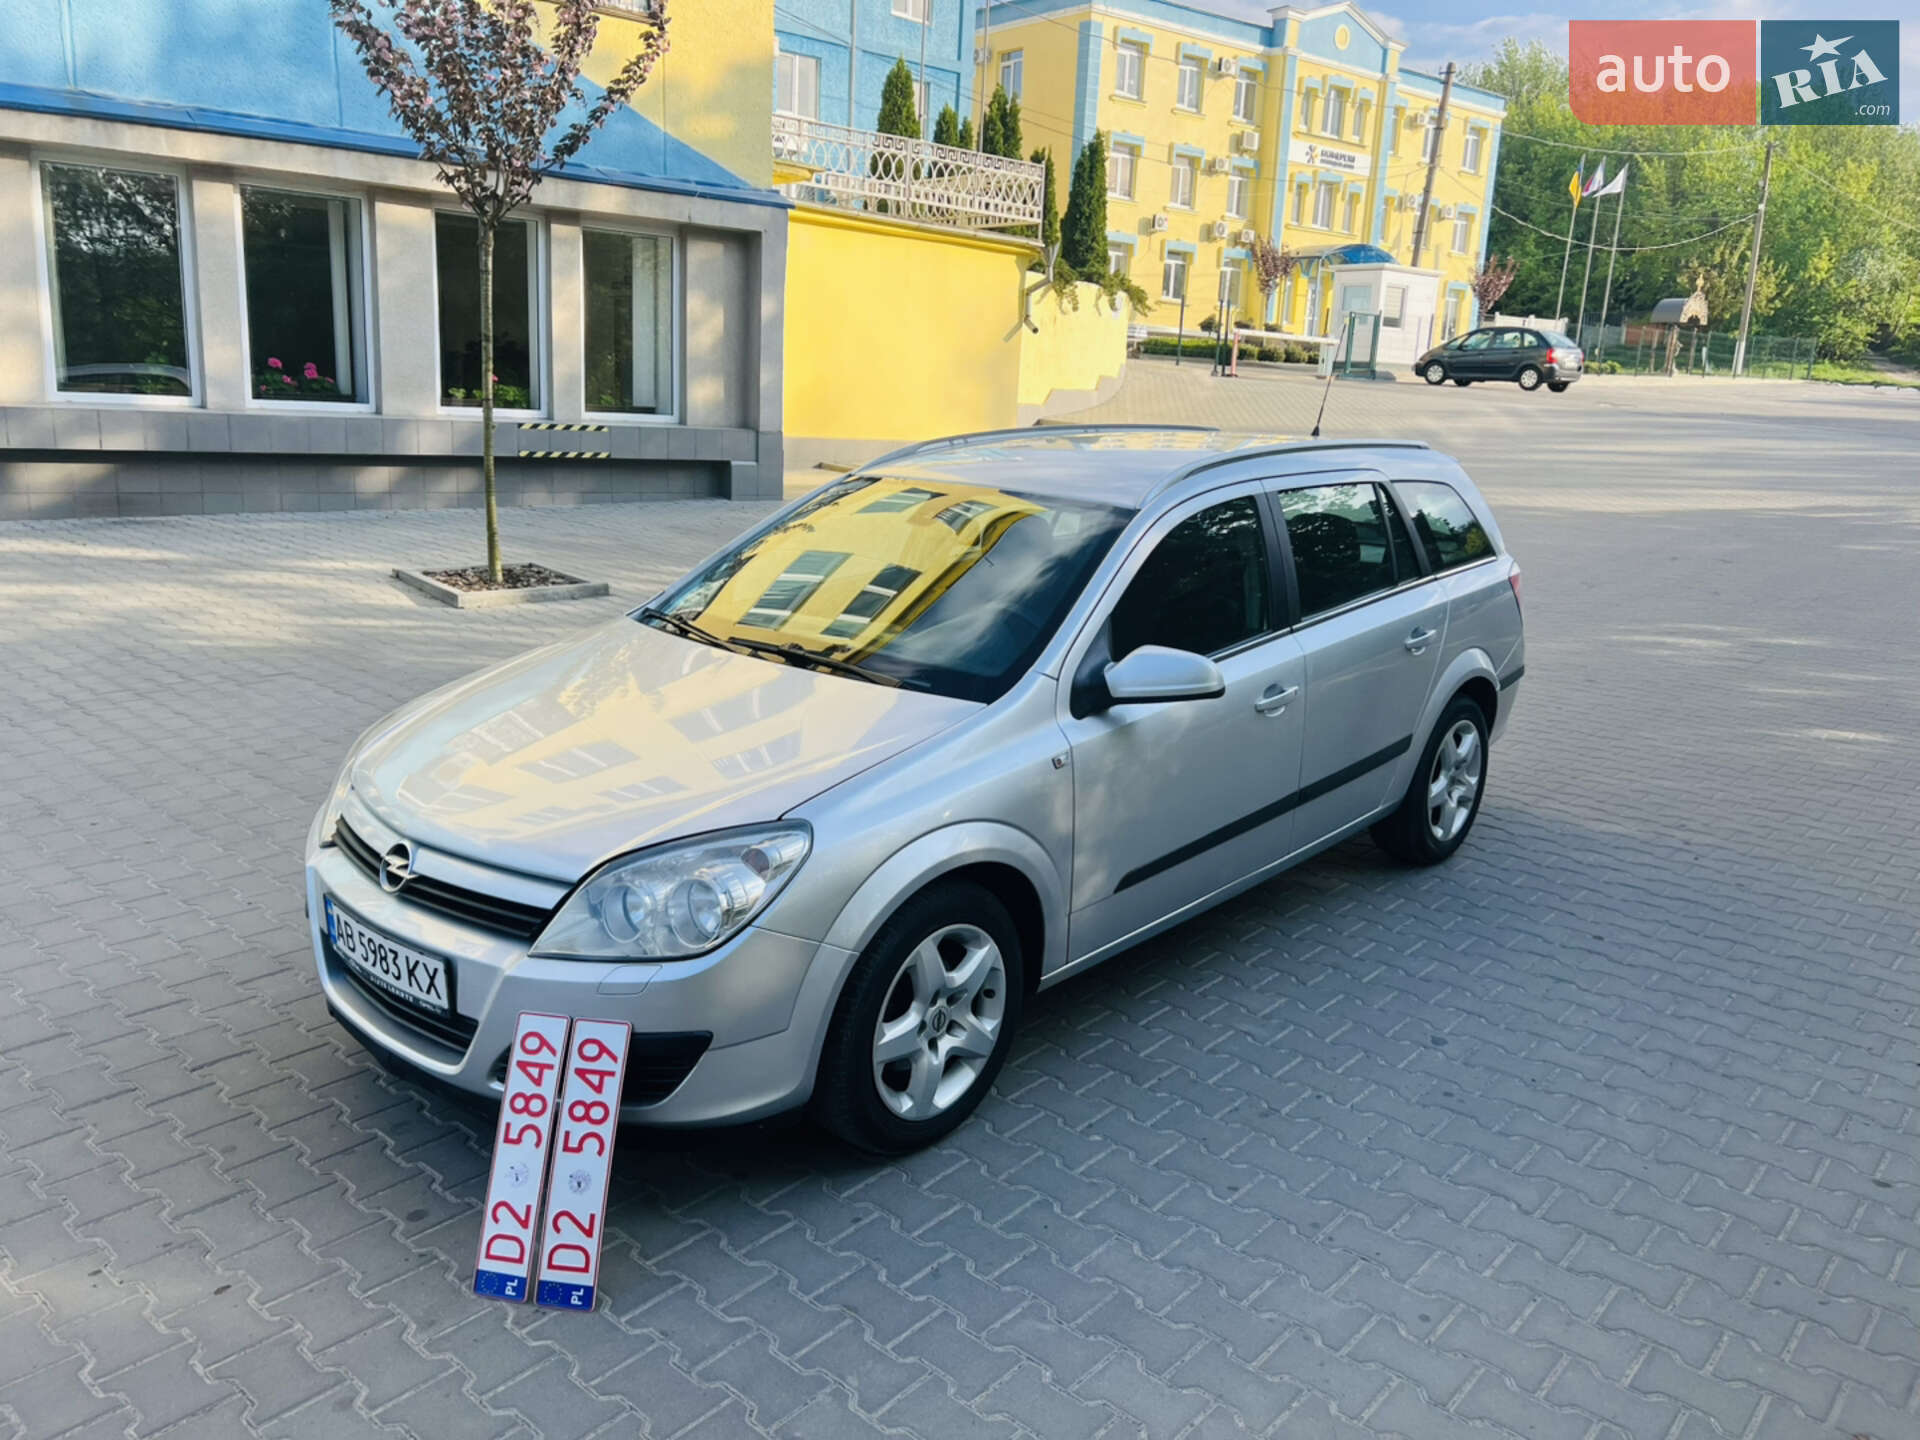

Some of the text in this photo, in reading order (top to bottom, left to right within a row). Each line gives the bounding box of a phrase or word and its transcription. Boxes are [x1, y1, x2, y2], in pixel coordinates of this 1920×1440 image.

[336, 913, 356, 953] AB
[358, 930, 402, 981] 5983
[406, 955, 442, 1000] KX
[503, 1031, 557, 1149] 5849
[562, 1038, 618, 1157] 5849
[485, 1200, 532, 1264] D2
[547, 1210, 596, 1274] D2
[505, 1278, 518, 1296] PL
[570, 1287, 584, 1305] PL
